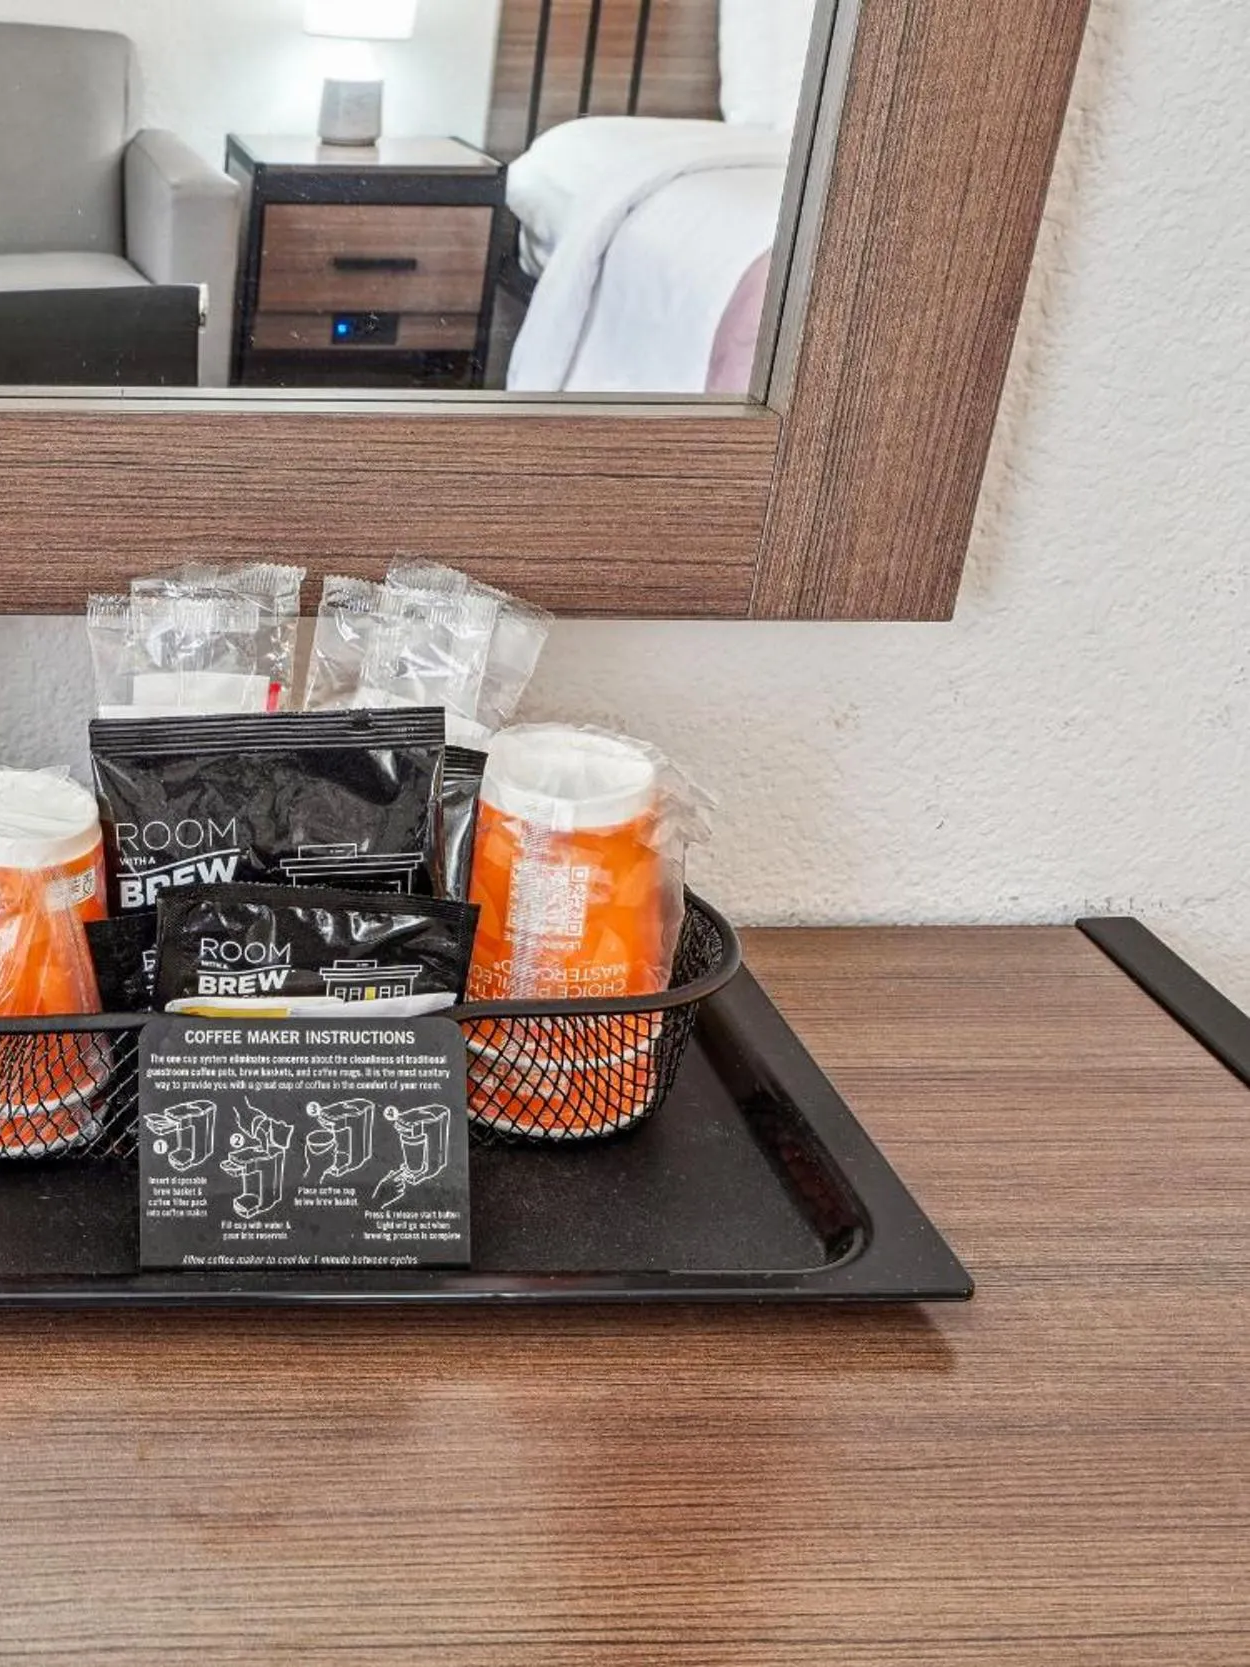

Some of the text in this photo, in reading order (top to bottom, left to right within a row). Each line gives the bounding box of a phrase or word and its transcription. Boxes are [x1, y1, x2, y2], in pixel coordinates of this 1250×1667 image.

[116, 817, 238, 851] ROOM
[119, 857, 156, 867] WITH A
[199, 938, 291, 964] ROOM
[198, 969, 289, 995] BREW
[185, 1030, 415, 1045] COFFEE MAKER INSTRUCTIONS
[151, 1053, 447, 1066] The one cup system eliminates concerns about the cleanliness of traditional
